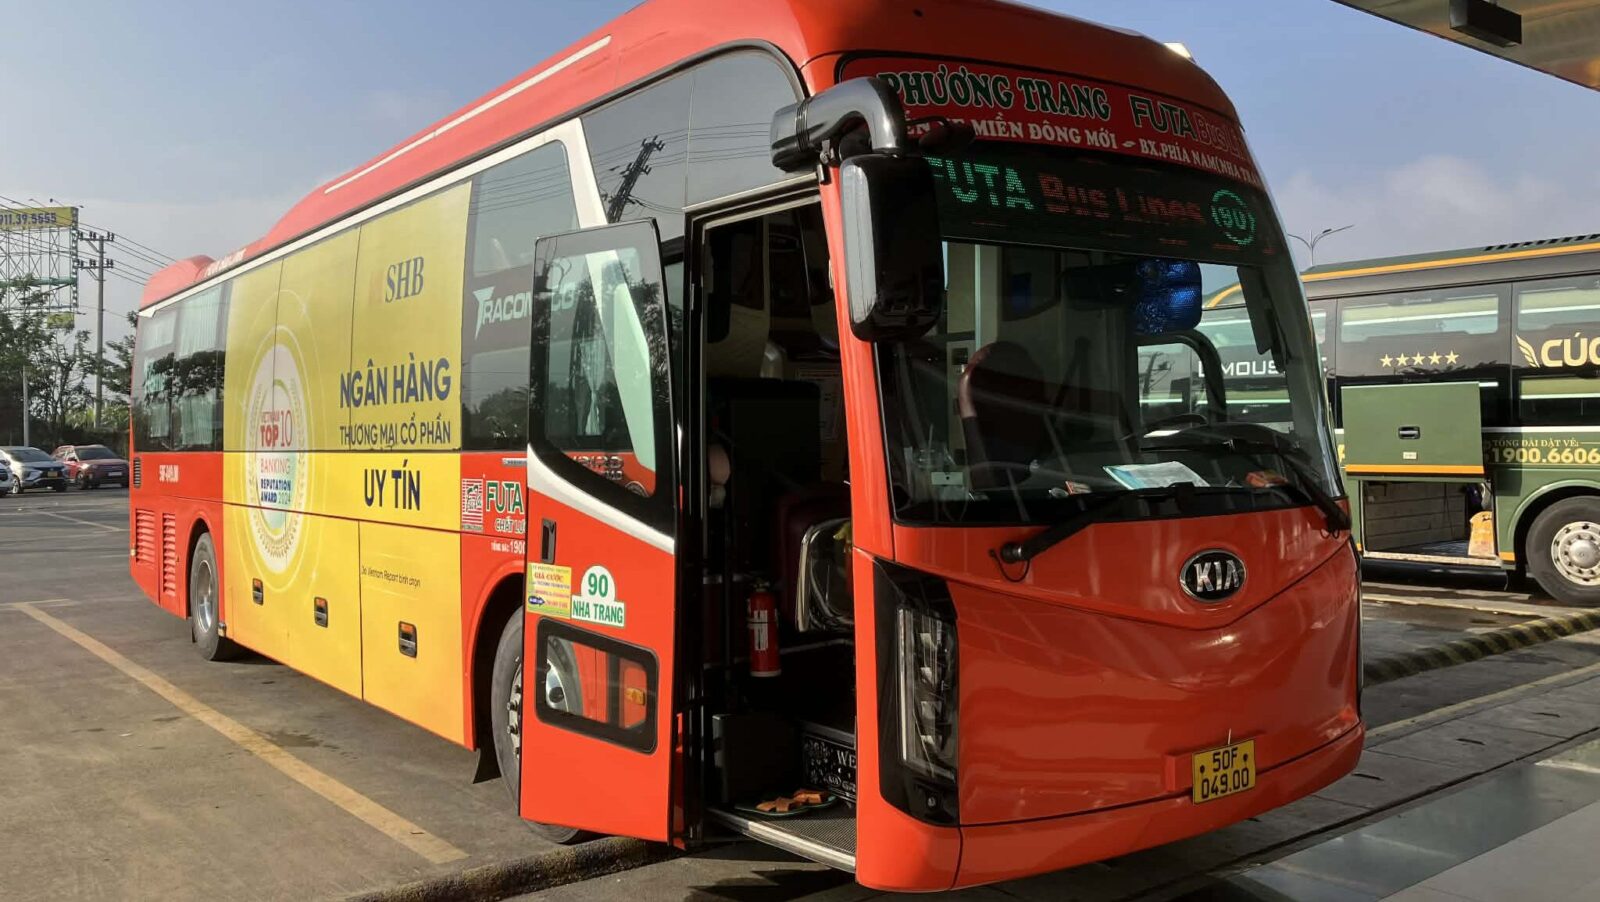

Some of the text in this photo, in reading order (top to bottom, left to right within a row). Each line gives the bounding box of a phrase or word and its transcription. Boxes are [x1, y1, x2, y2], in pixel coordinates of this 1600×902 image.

[1017, 77, 1112, 121] TRANG
[1128, 93, 1199, 142] FUTA
[970, 112, 1024, 139] MIỀN
[1028, 120, 1081, 144] ĐÔNG
[1085, 127, 1118, 149] MỚI
[384, 256, 425, 304] SHB
[339, 352, 451, 409] NGÂN HÀNG
[260, 409, 293, 448] TOP 10
[340, 422, 378, 446] THƯƠNG
[400, 411, 418, 446] CỔ
[420, 411, 451, 444] PHẦN
[261, 458, 291, 474] BANKING
[260, 478, 292, 491] REPUTATION
[260, 491, 278, 504] AWARD
[364, 458, 421, 512] UY TÍN
[485, 480, 526, 515] FUTA
[587, 572, 609, 598] 90
[1193, 559, 1240, 593] KIA
[572, 600, 624, 625] NHA TRANG
[1212, 747, 1239, 773] 50F
[1200, 768, 1250, 800] 049.00
